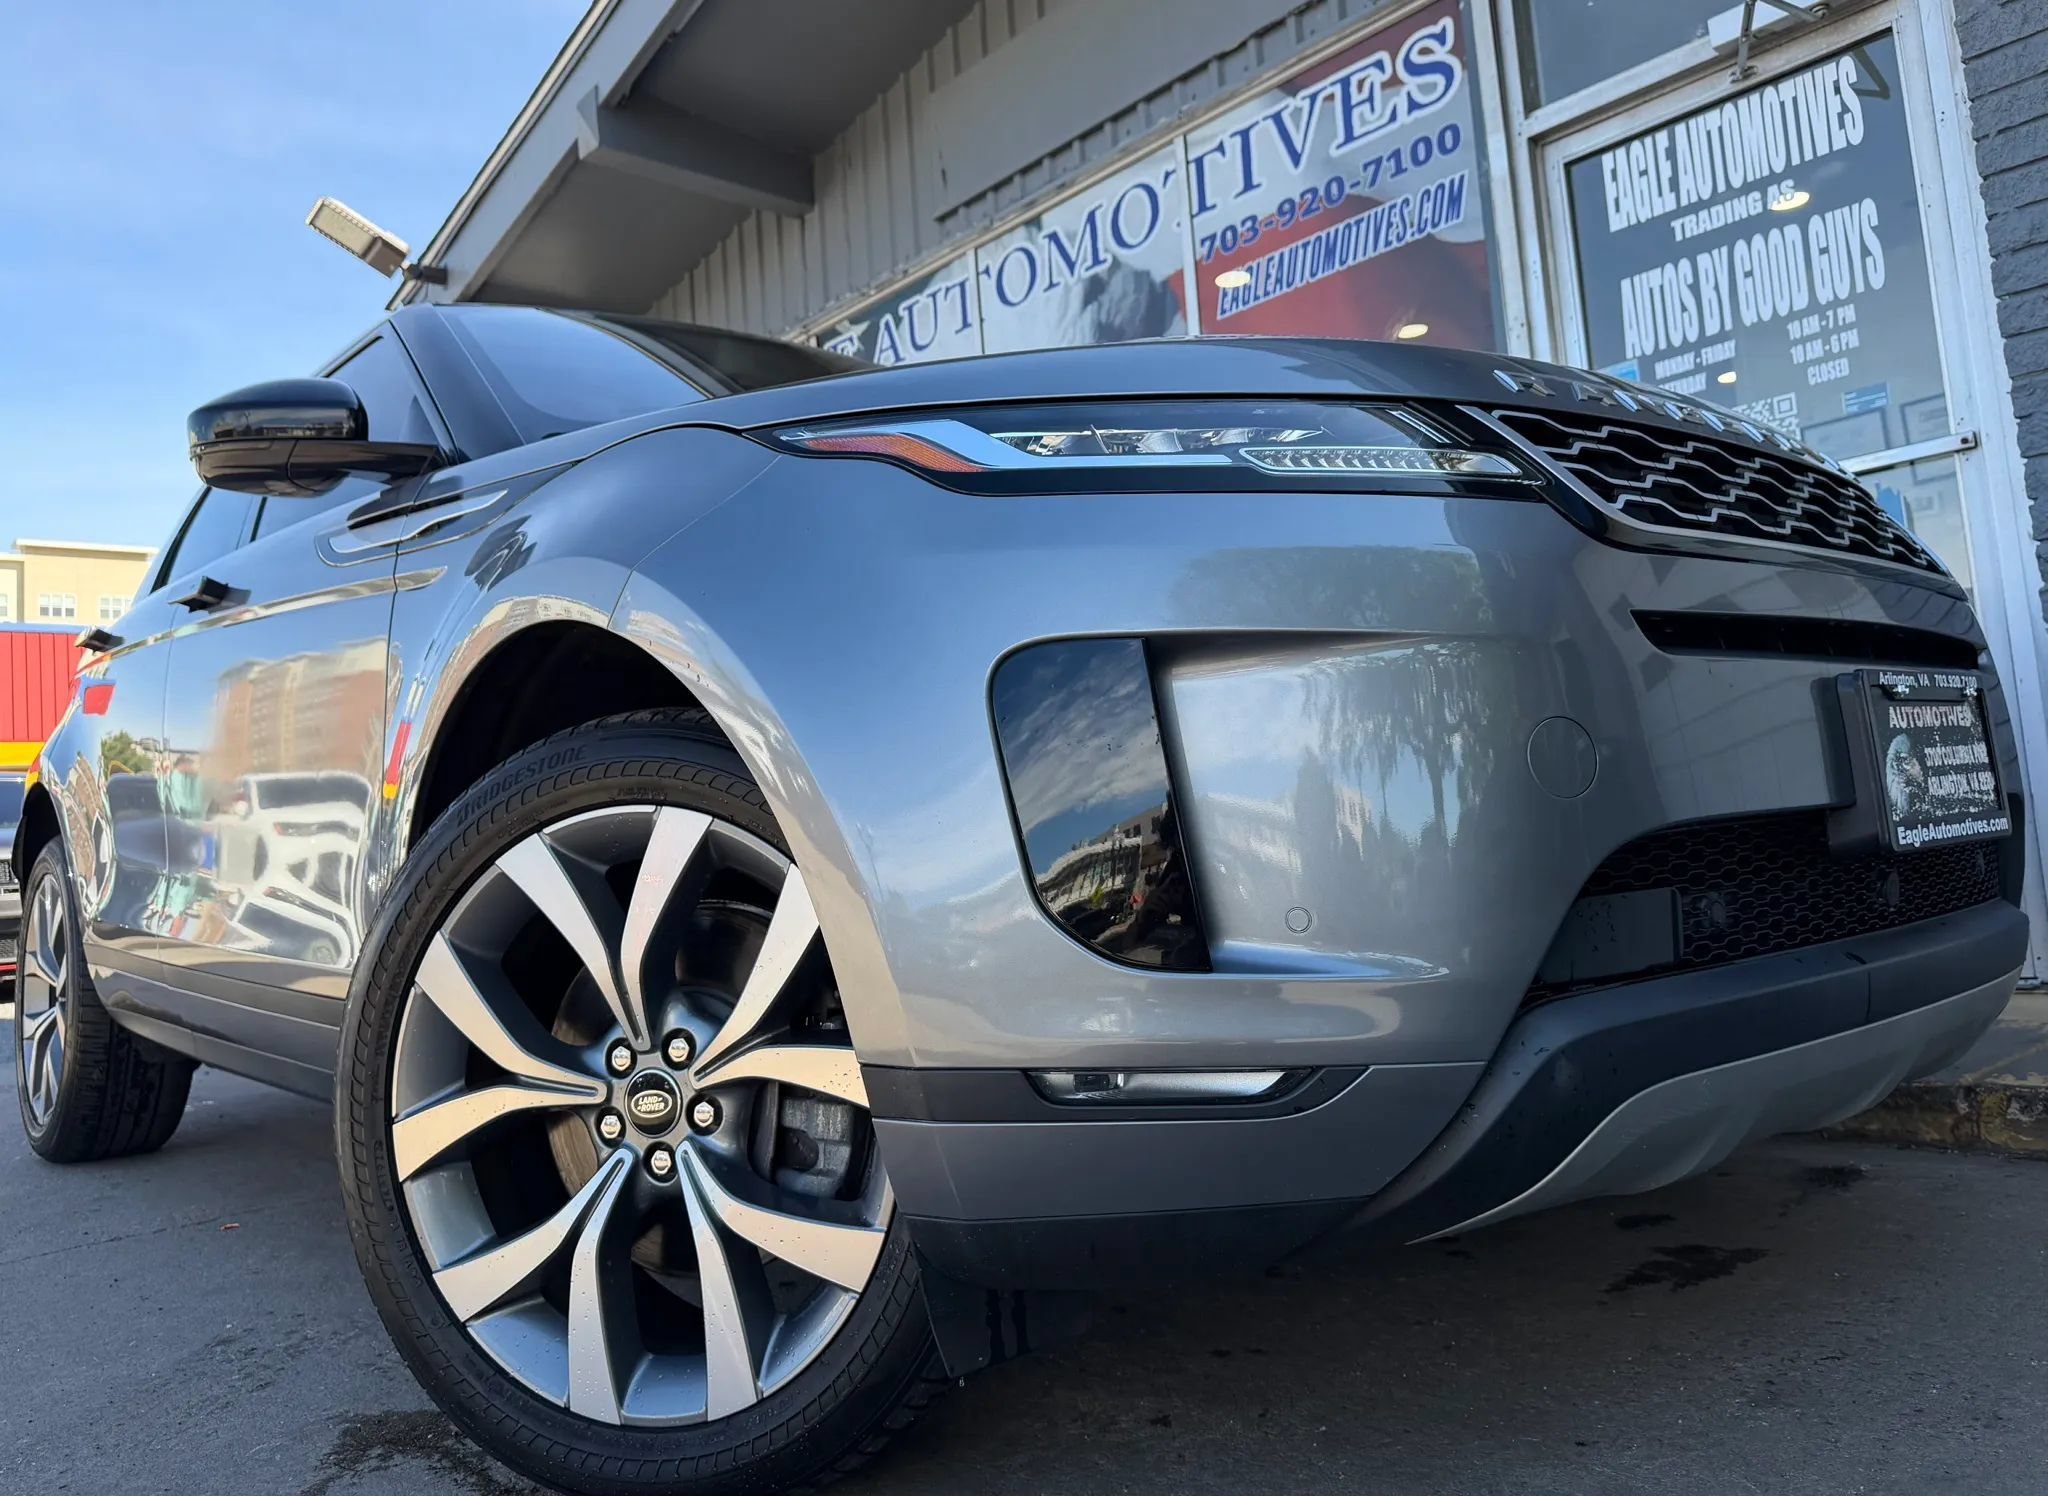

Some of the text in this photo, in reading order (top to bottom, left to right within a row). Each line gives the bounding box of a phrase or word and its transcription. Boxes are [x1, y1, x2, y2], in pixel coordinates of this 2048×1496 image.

[1601, 55, 1864, 233] EAGLE AUTOMOTIVES
[871, 16, 1464, 364] AUTOMOTIVES
[1199, 122, 1461, 264] 703-920-7100
[1671, 179, 1796, 242] TRADING AS
[1217, 171, 1468, 319] EAGLEAUTOMOTIVES.COM
[1620, 197, 1886, 359] AUTOS BY GOOD GUYS
[1786, 320, 1801, 340] 10
[1802, 313, 1820, 337] AM
[1837, 303, 1856, 326] PM
[1654, 351, 1695, 381] MONDAY
[1701, 339, 1736, 367] FRIDAY
[1789, 344, 1805, 364] 10
[1805, 338, 1824, 361] AM
[1830, 334, 1840, 354] 6
[1840, 328, 1859, 351] PM
[1807, 357, 1850, 386] CLOSED
[1879, 671, 1918, 688] Arlington,
[1917, 673, 1930, 687] VA
[1889, 704, 1974, 729] AUTOMOTIVES
[456, 744, 589, 828] BRIDGESTONE
[1897, 817, 2008, 847] EagleAutomotives.com
[638, 1095, 658, 1104] LAND
[640, 1102, 665, 1112] ROVER
